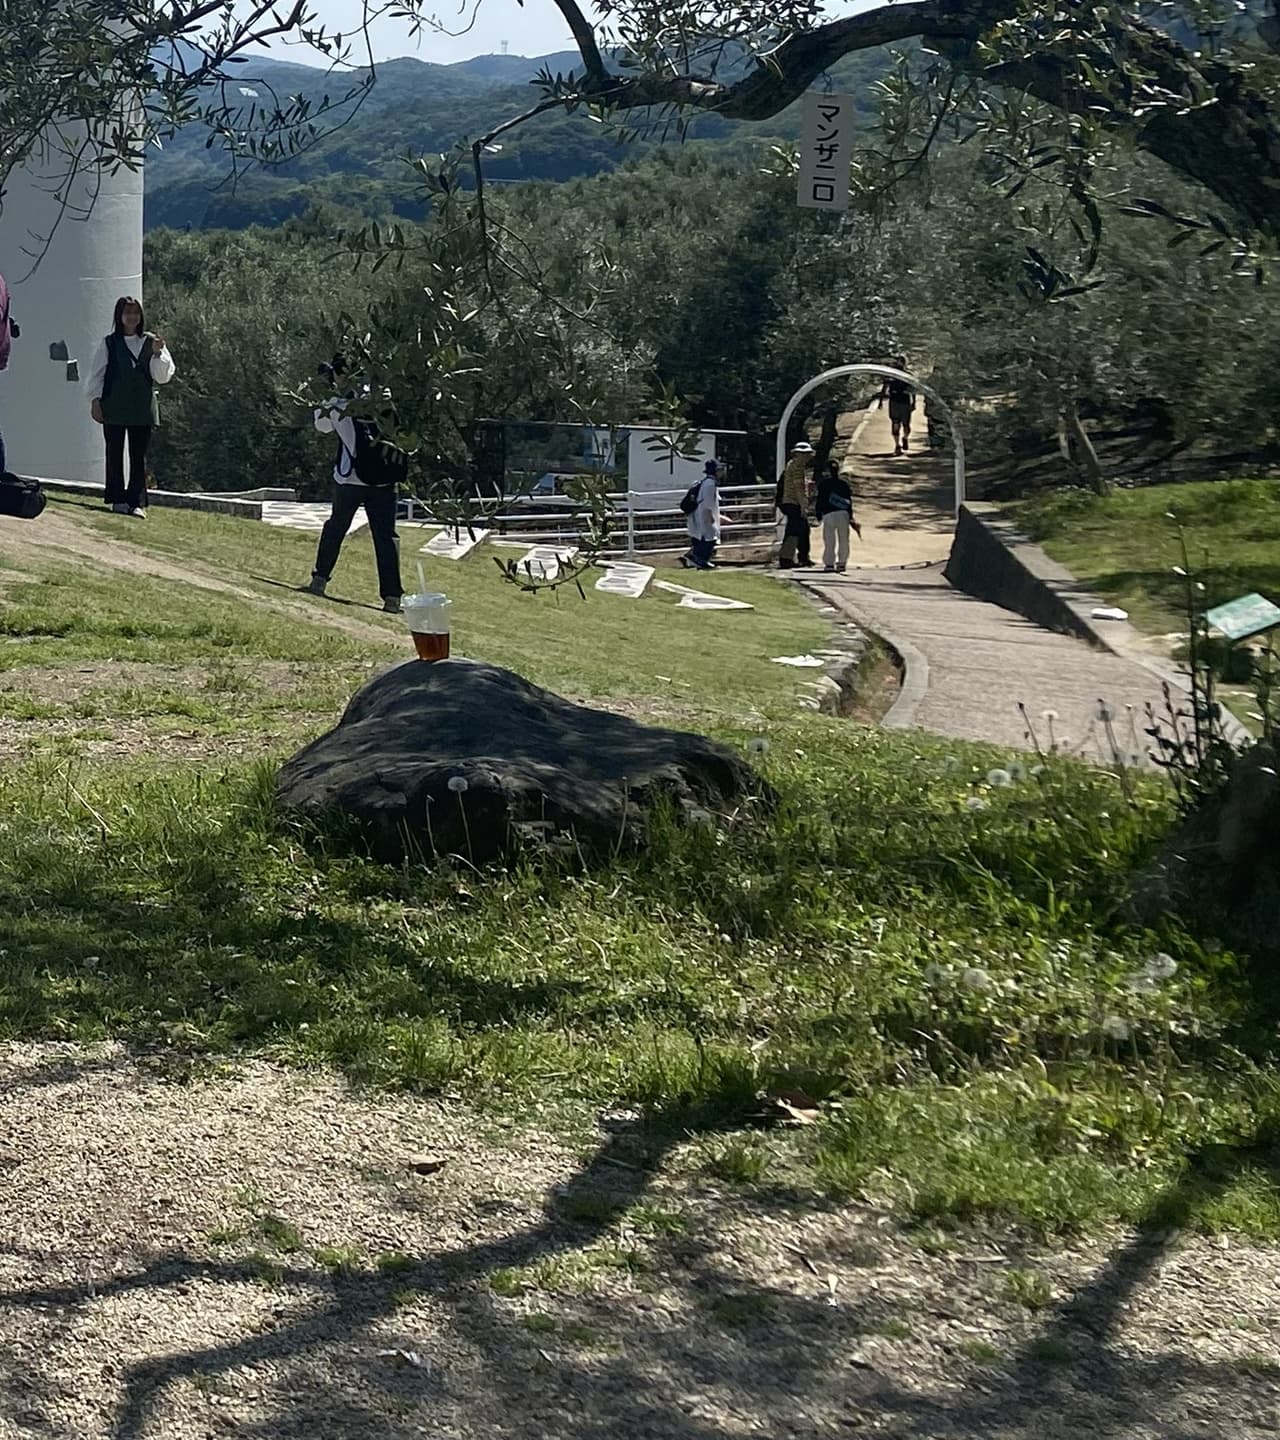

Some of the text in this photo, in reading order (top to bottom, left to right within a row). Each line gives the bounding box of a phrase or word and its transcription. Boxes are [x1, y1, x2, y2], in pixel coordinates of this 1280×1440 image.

[813, 104, 840, 202] マンザニロ
